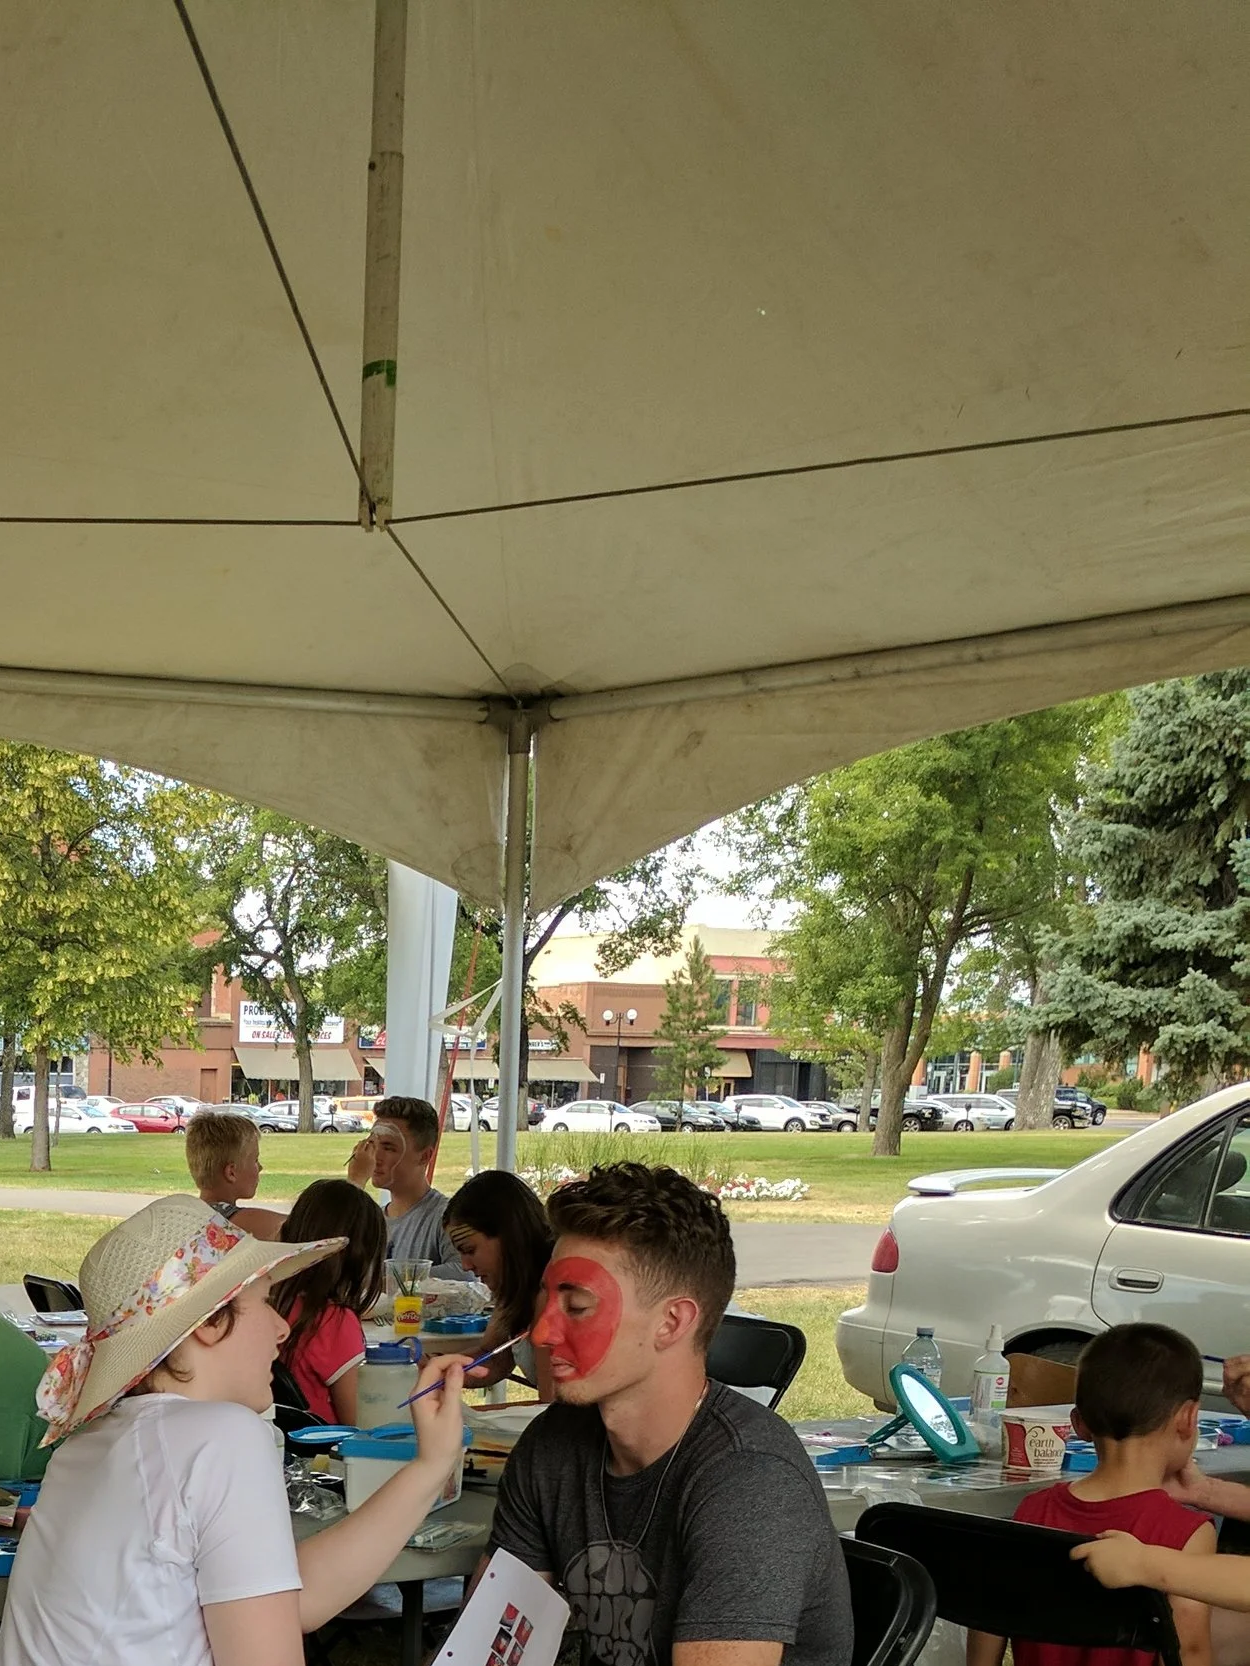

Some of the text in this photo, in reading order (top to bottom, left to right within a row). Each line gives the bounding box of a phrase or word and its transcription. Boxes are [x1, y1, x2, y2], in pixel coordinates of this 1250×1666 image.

[252, 1030, 259, 1039] ON
[262, 1030, 275, 1039] SALE
[1029, 1438, 1054, 1448] earth
[1034, 1448, 1063, 1457] balance
